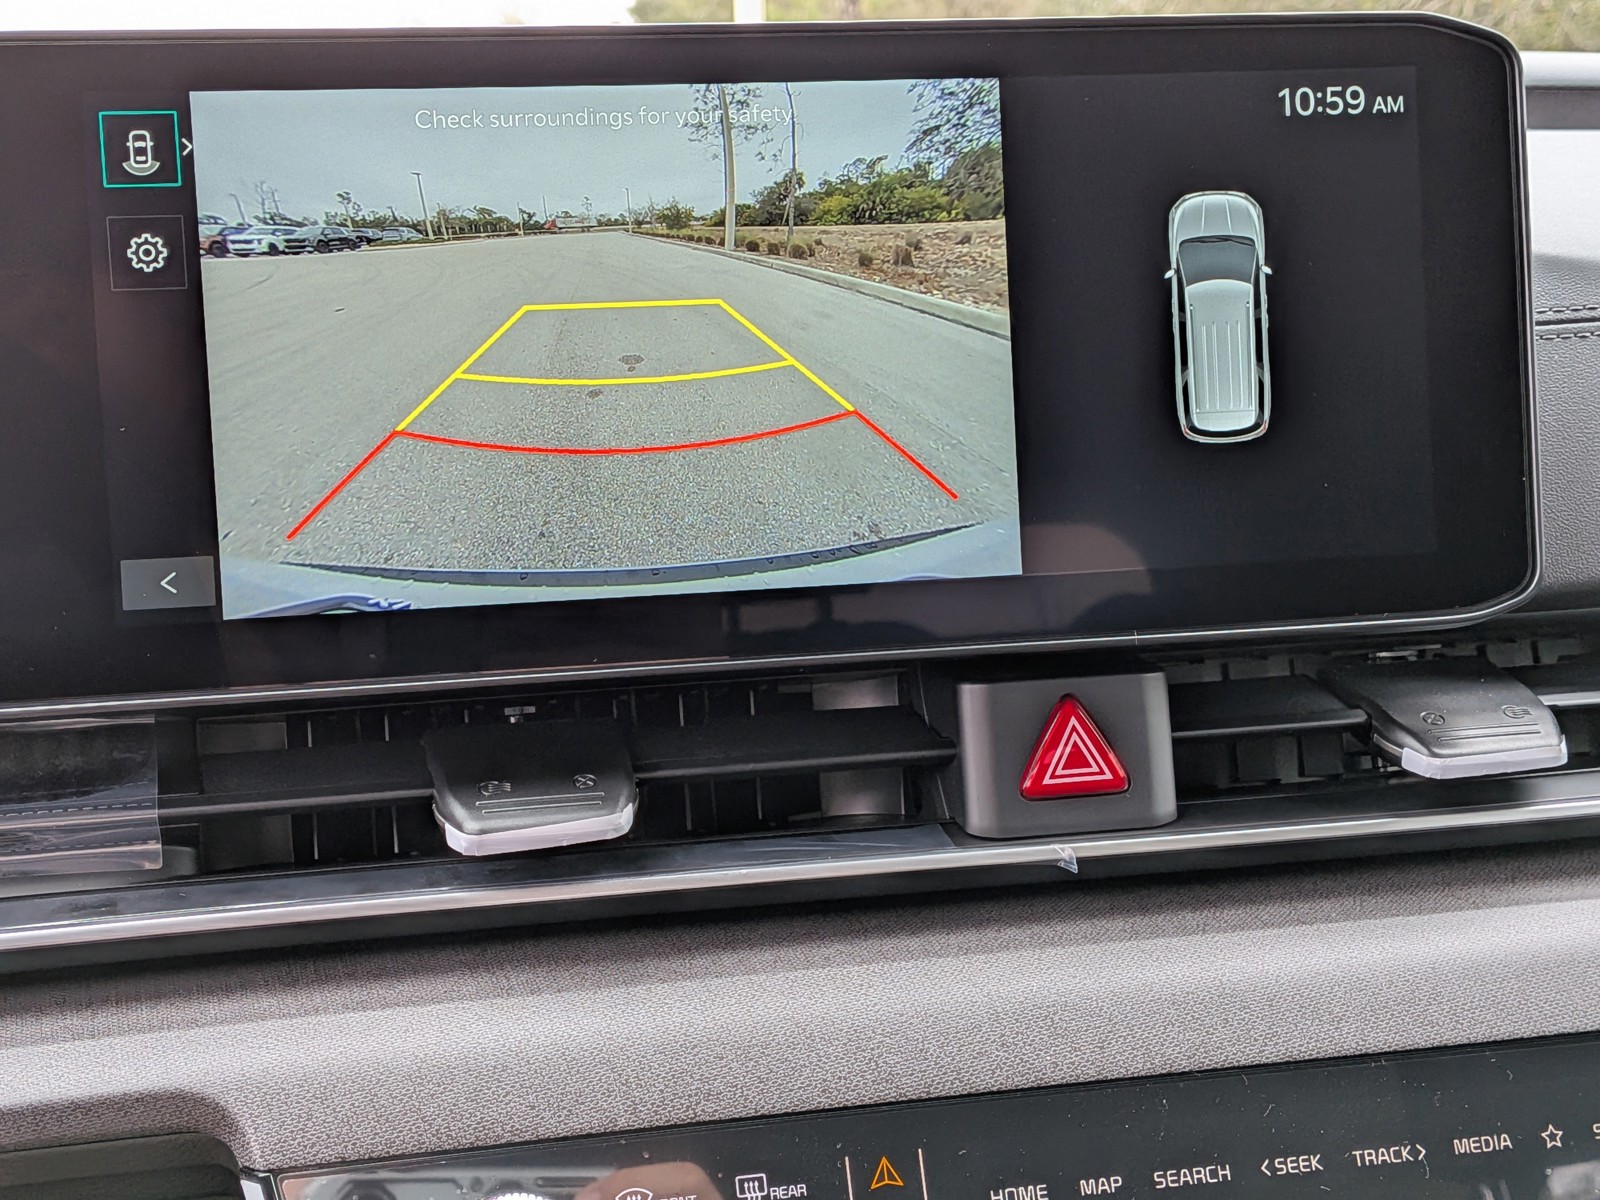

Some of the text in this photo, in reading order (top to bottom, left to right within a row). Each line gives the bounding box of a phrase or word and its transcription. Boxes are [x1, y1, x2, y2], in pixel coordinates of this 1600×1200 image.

[1278, 85, 1404, 117] 10:59 AM
[415, 109, 483, 129] Check
[490, 107, 633, 130] surroundings
[638, 105, 669, 125] for
[675, 110, 723, 128] your
[1453, 1133, 1513, 1155] MEDIA
[1275, 1154, 1324, 1175] SEEK
[1352, 1145, 1414, 1167] TRACK
[1079, 1176, 1123, 1196] MAP
[1153, 1164, 1232, 1189] SEARCH
[769, 1184, 807, 1200] REAR
[990, 1184, 1049, 1200] HOME
